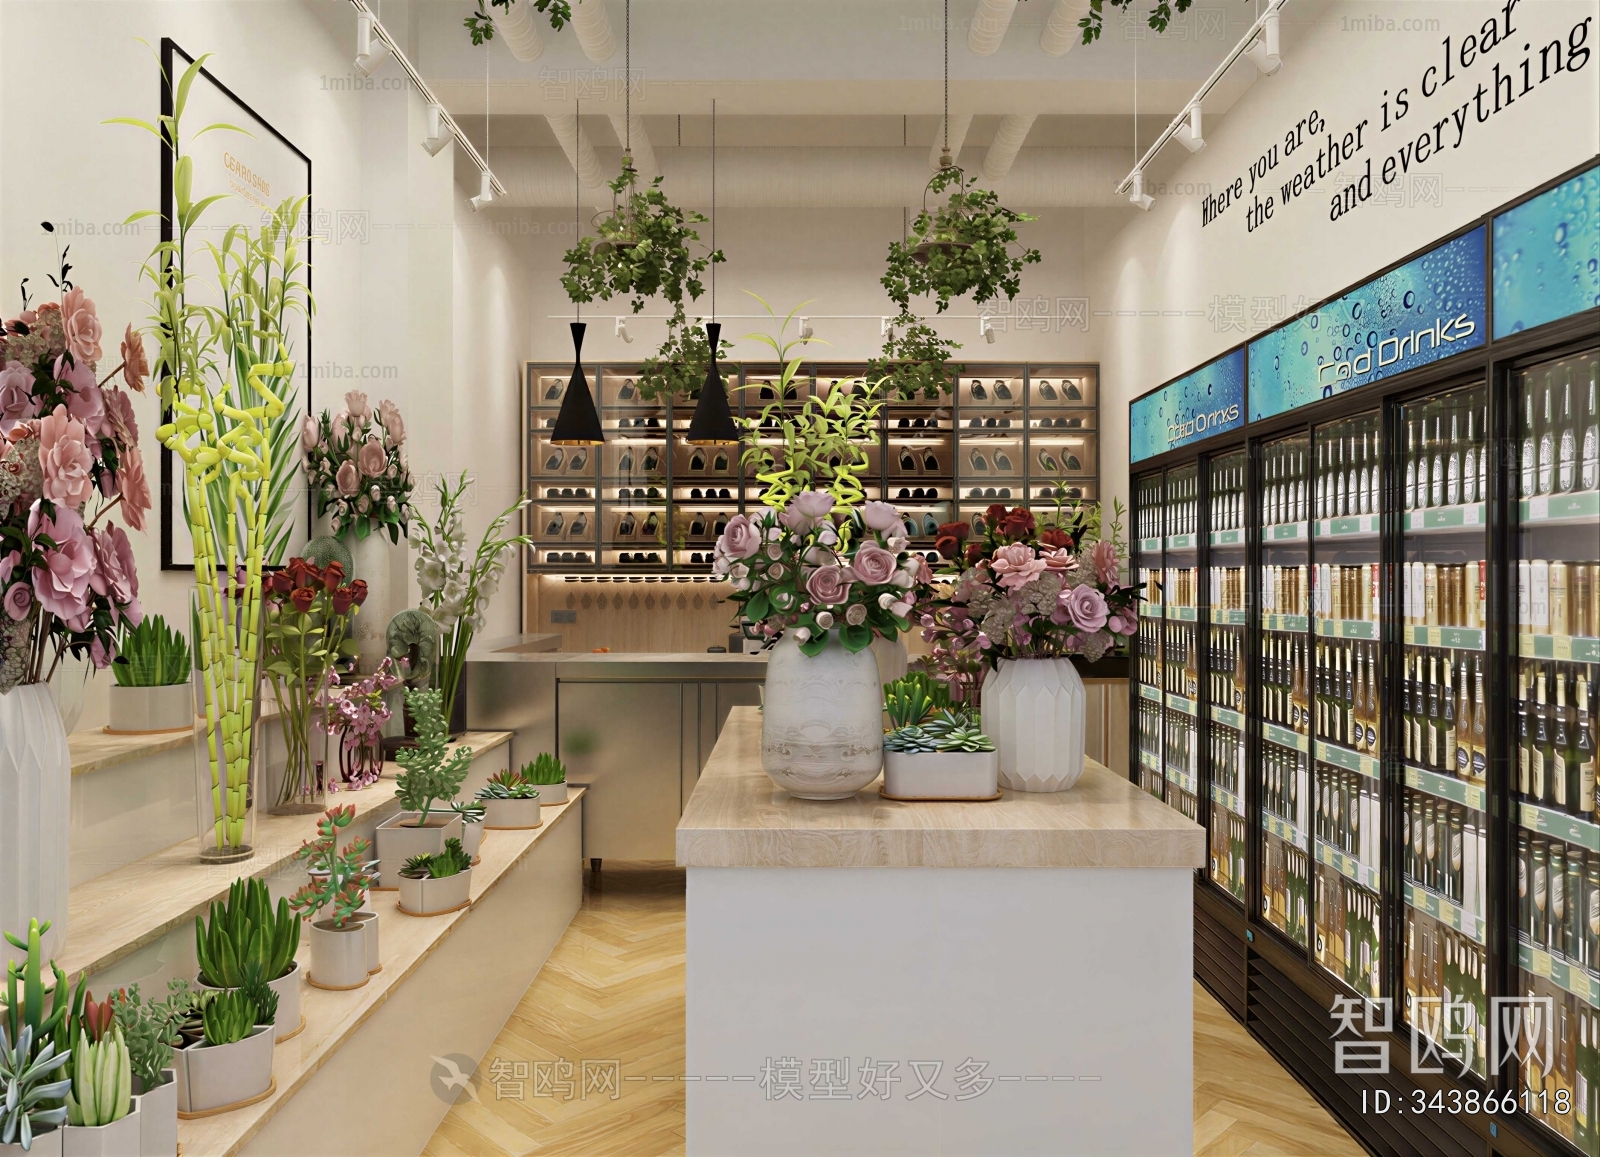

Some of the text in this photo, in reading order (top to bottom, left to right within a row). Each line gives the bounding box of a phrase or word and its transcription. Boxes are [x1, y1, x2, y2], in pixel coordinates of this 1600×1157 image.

[1202, 109, 1326, 228] Where you are,
[1246, 0, 1518, 233] the weather is clear
[1330, 17, 1592, 222] and everything
